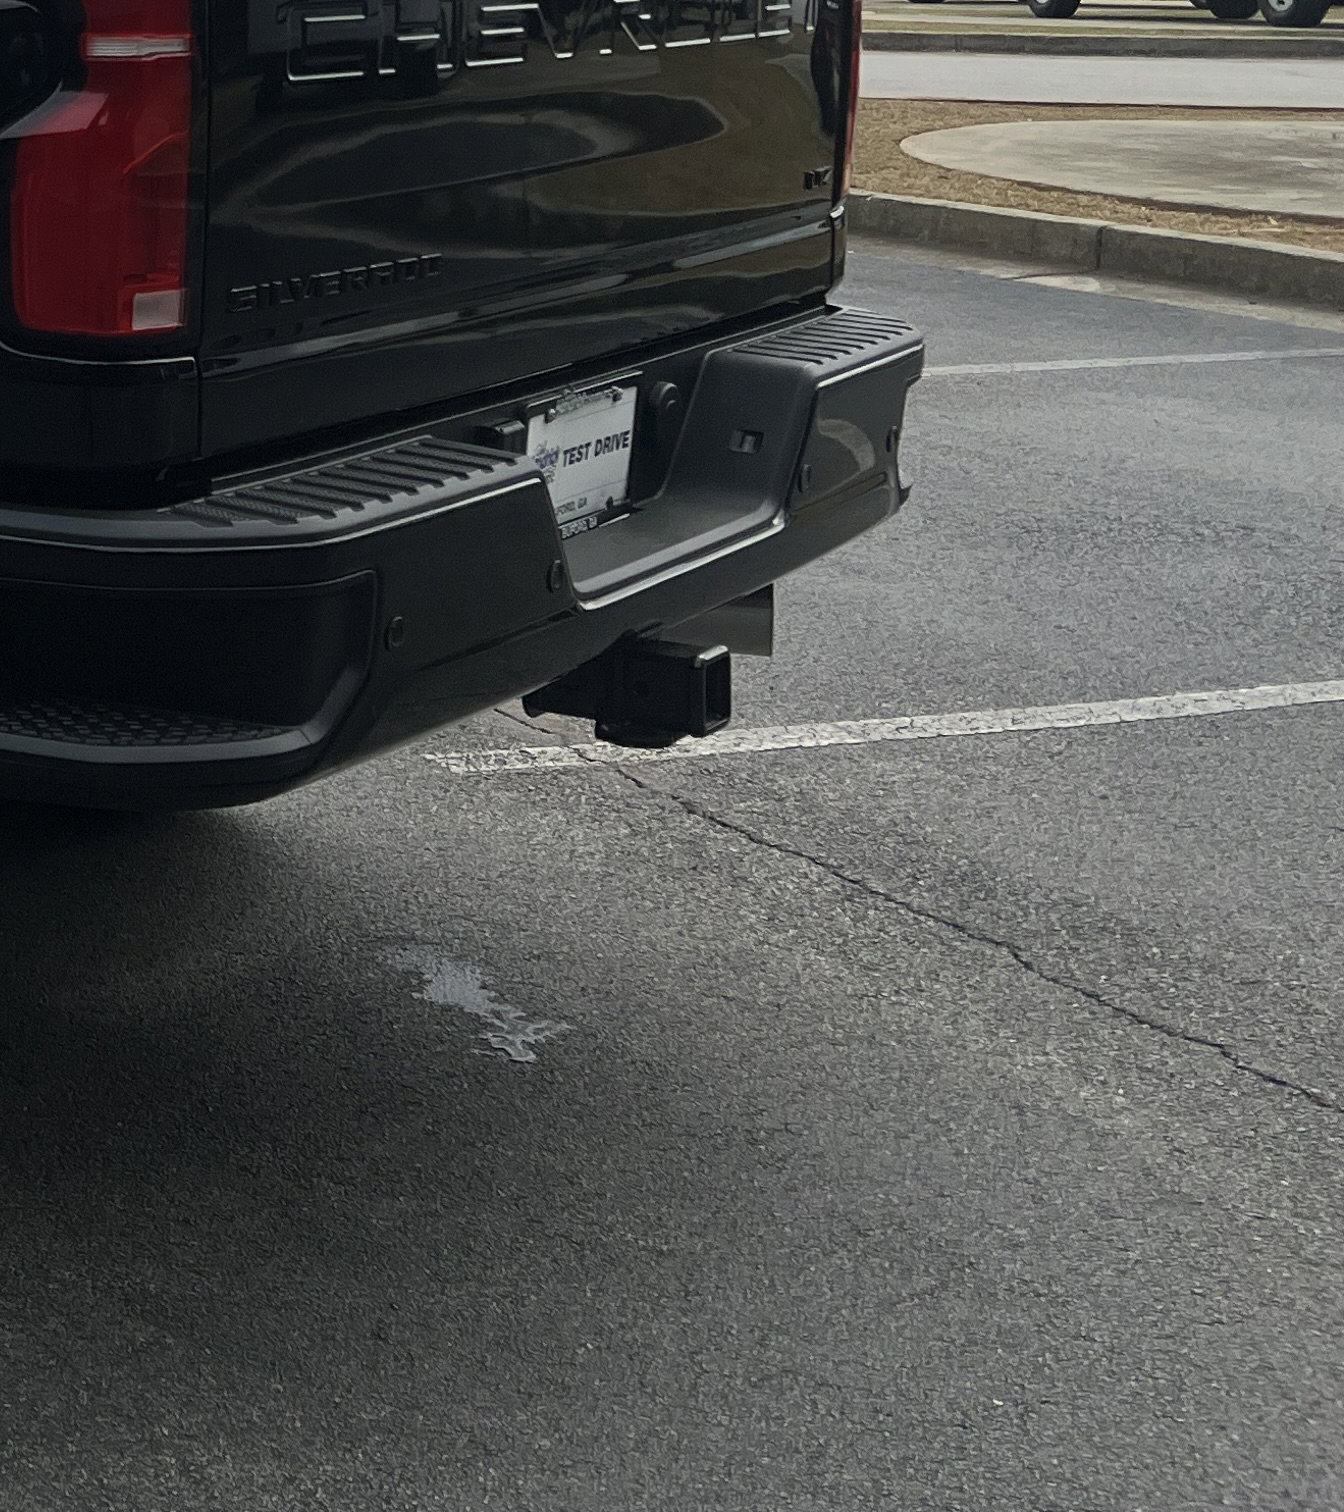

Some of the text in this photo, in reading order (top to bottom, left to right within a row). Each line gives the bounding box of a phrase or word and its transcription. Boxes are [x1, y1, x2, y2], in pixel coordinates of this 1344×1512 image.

[226, 252, 443, 313] SILVERADO
[562, 441, 593, 468] TEST
[593, 430, 631, 457] DRIVE
